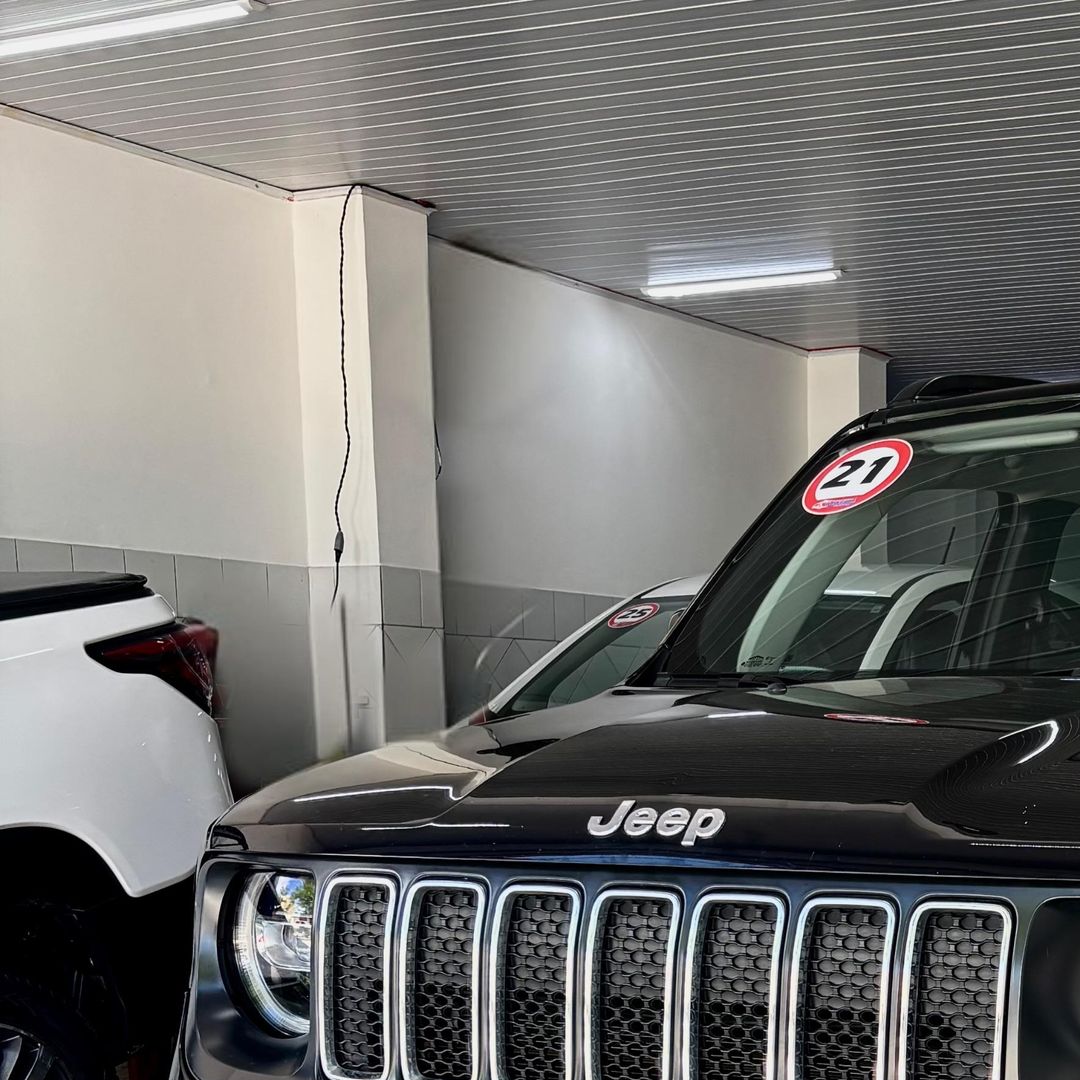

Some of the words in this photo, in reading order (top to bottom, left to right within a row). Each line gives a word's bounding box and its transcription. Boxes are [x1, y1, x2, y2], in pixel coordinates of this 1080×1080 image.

[819, 455, 894, 490] 21
[616, 608, 653, 620] 25
[587, 800, 726, 846] Jeep
